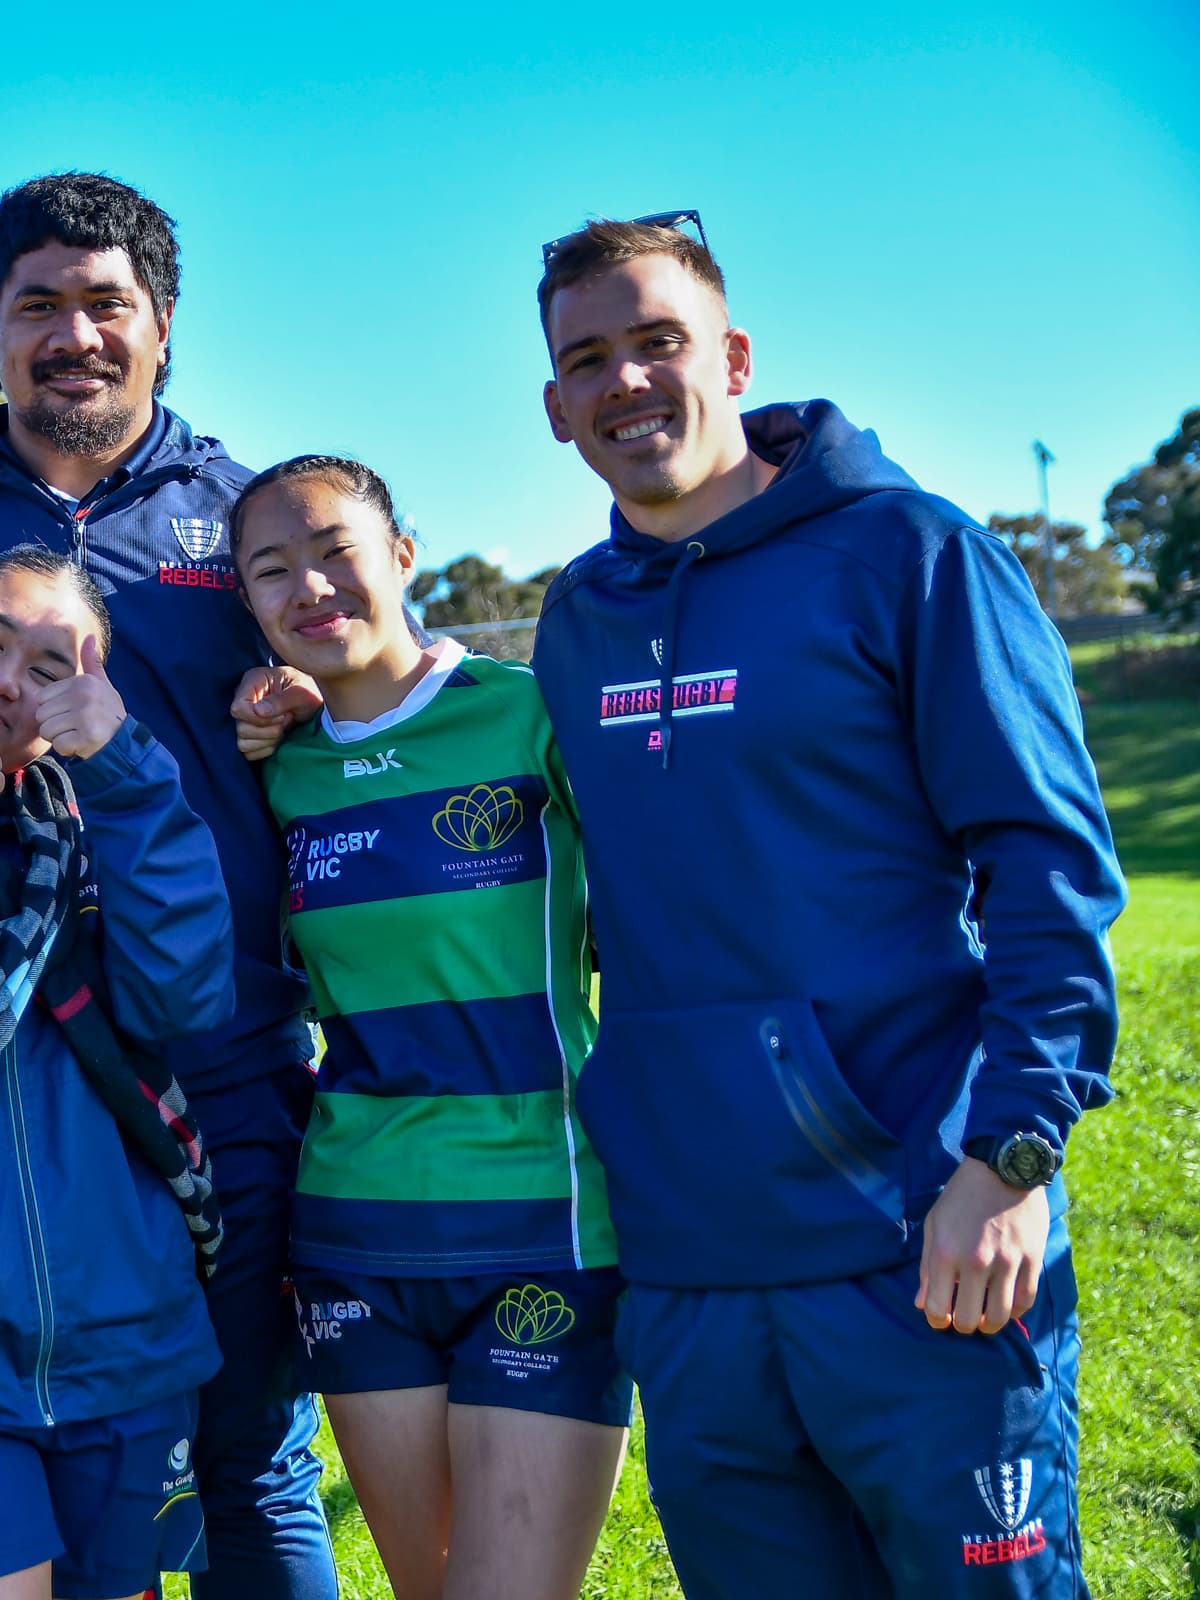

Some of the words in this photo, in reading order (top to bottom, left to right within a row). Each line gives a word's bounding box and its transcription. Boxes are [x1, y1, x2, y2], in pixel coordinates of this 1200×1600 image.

[159, 560, 235, 574] MELBOURNE
[160, 567, 237, 590] REBELS
[605, 686, 661, 717] REBELS
[672, 678, 724, 708] UGBY
[344, 749, 403, 778] BLK
[308, 829, 381, 860] RUGBY
[307, 857, 341, 881] VIC
[441, 857, 498, 872] FOUNTAIN
[500, 854, 524, 865] GATE
[475, 880, 501, 889] RUGBY
[311, 1300, 371, 1320] RUGBY
[312, 1320, 342, 1339] VIC
[489, 1348, 531, 1360] FOUNTAIN
[533, 1353, 559, 1363] GATE
[963, 1524, 1047, 1566] REBELS
